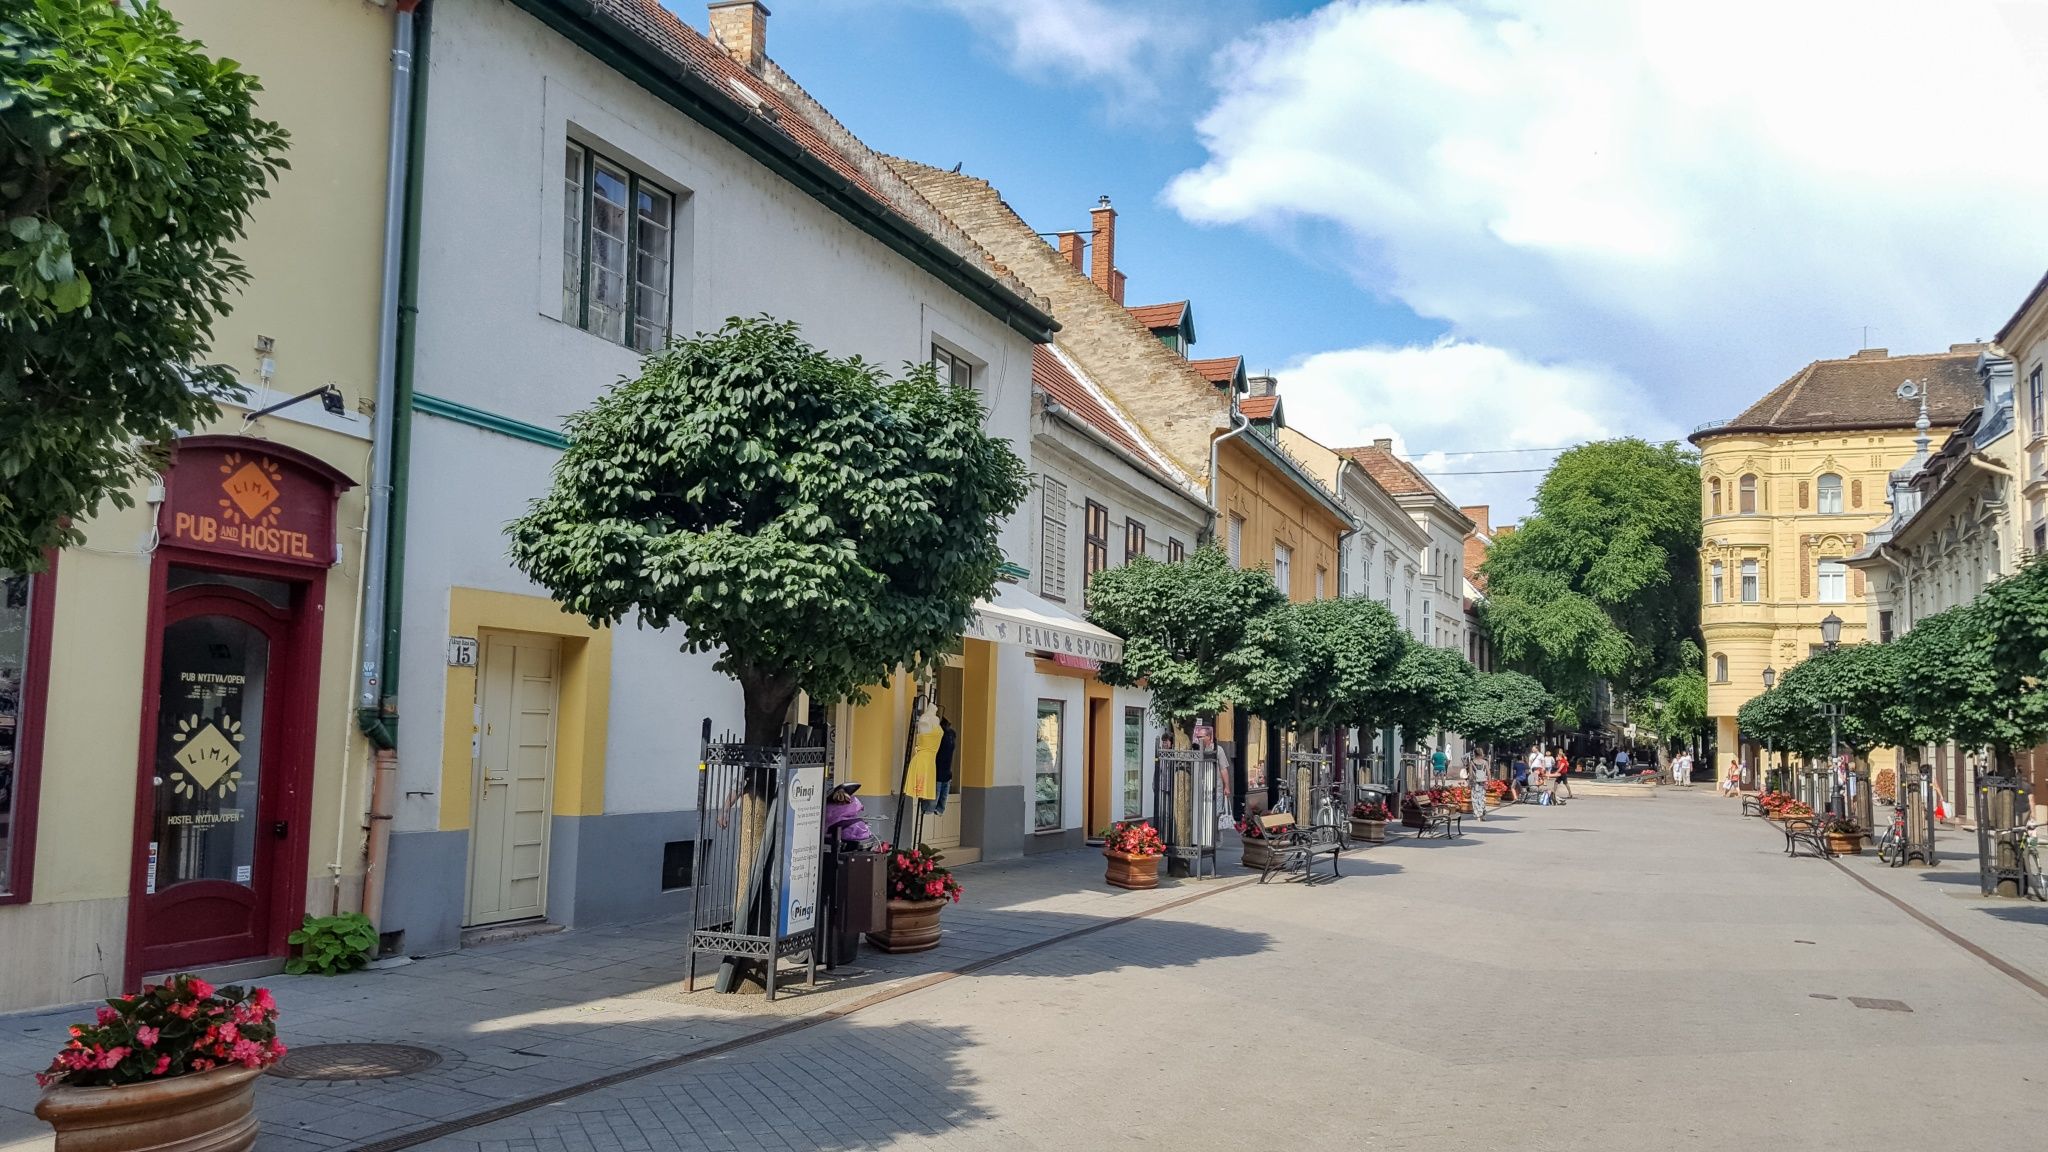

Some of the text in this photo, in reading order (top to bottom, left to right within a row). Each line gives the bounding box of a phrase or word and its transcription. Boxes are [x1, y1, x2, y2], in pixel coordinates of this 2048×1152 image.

[234, 481, 269, 500] LIMA
[176, 513, 315, 559] PUB AND HOSTEL
[456, 646, 470, 663] 15
[1064, 635, 1073, 652] &
[1077, 637, 1113, 660] SPORT
[181, 672, 246, 684] PUB NYITVA/OPEN
[187, 747, 230, 765] LIMA
[795, 785, 815, 802] Pingi
[167, 813, 240, 825] HOSTEL NYITVA/OPEN
[794, 902, 814, 920] Pingi
